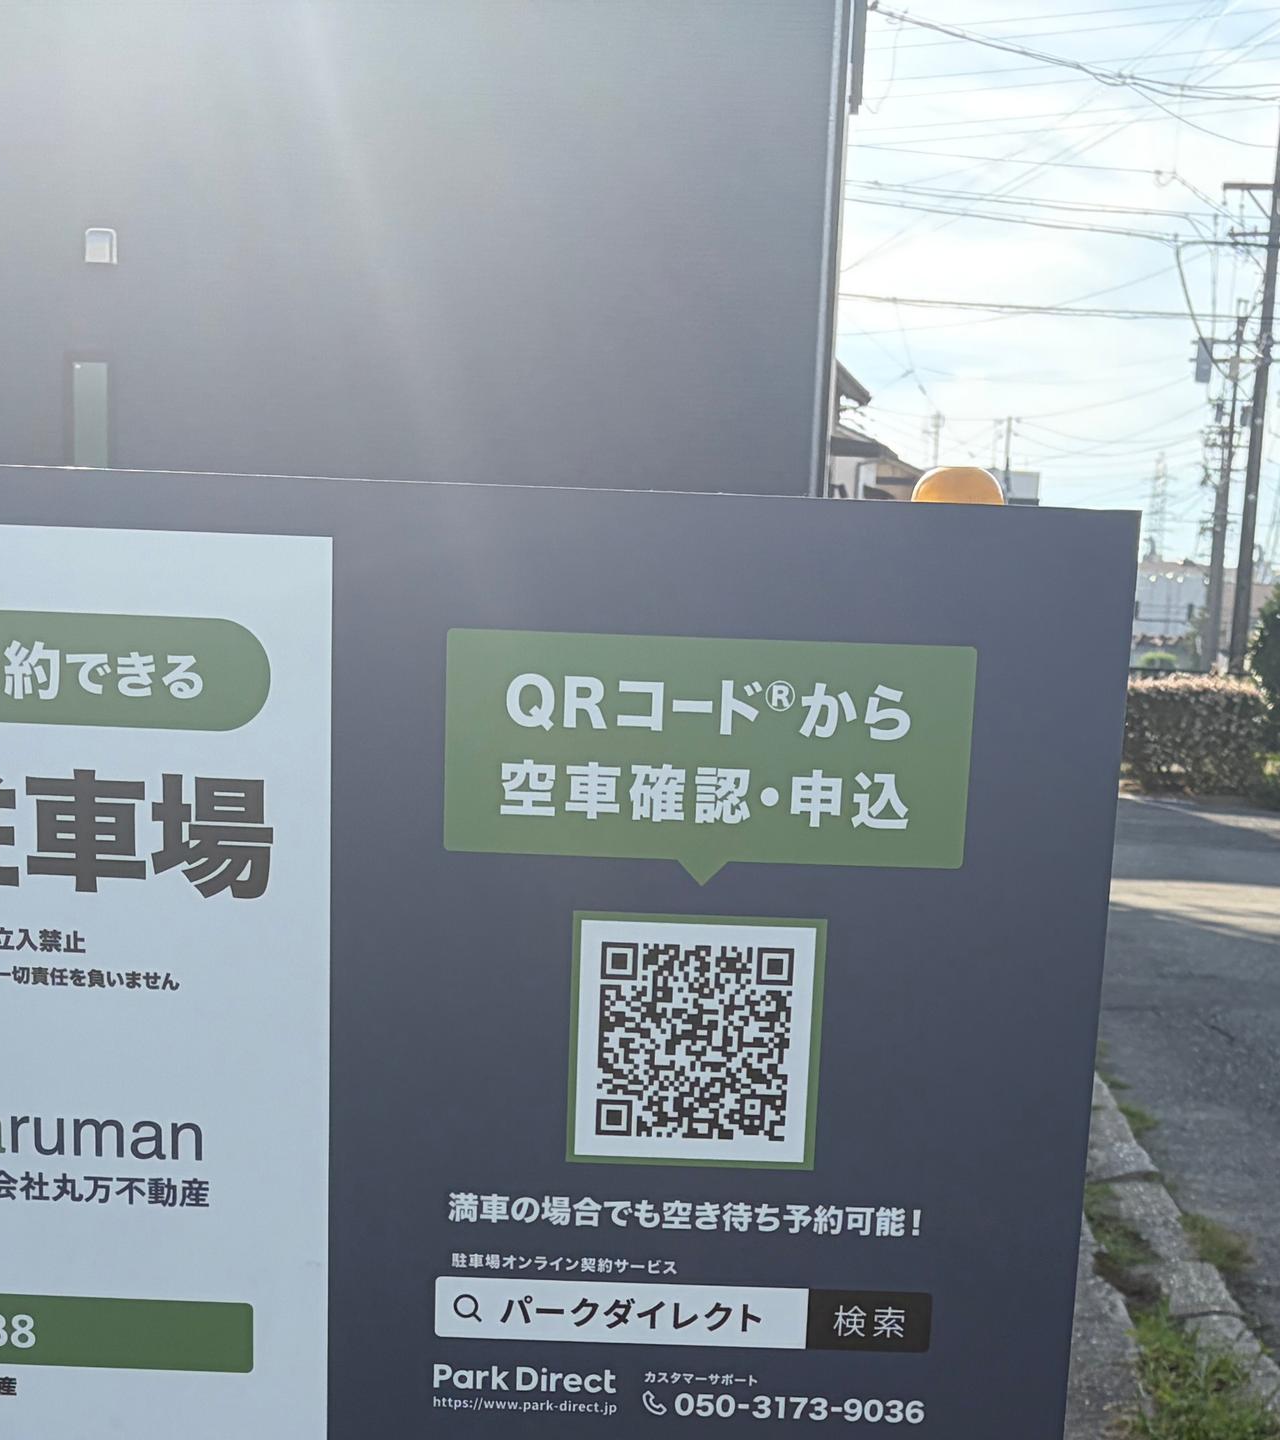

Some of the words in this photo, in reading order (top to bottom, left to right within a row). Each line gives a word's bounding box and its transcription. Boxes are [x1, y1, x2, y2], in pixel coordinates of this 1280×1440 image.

[499, 758, 909, 830] 空車確認・申込
[448, 1192, 922, 1237] 満車の場合でも空き待ち予約可能!
[450, 1252, 678, 1275] 駐車場オンライン契約サービス
[499, 1295, 762, 1333] パークダイレクト
[833, 1304, 905, 1339] 検索
[433, 1363, 510, 1391] Park
[515, 1366, 617, 1394] Direct
[644, 1371, 758, 1387] カスタマーサポート
[432, 1395, 618, 1416] https://www.park-direct.jp
[674, 1392, 925, 1424] 050-3173-9036
